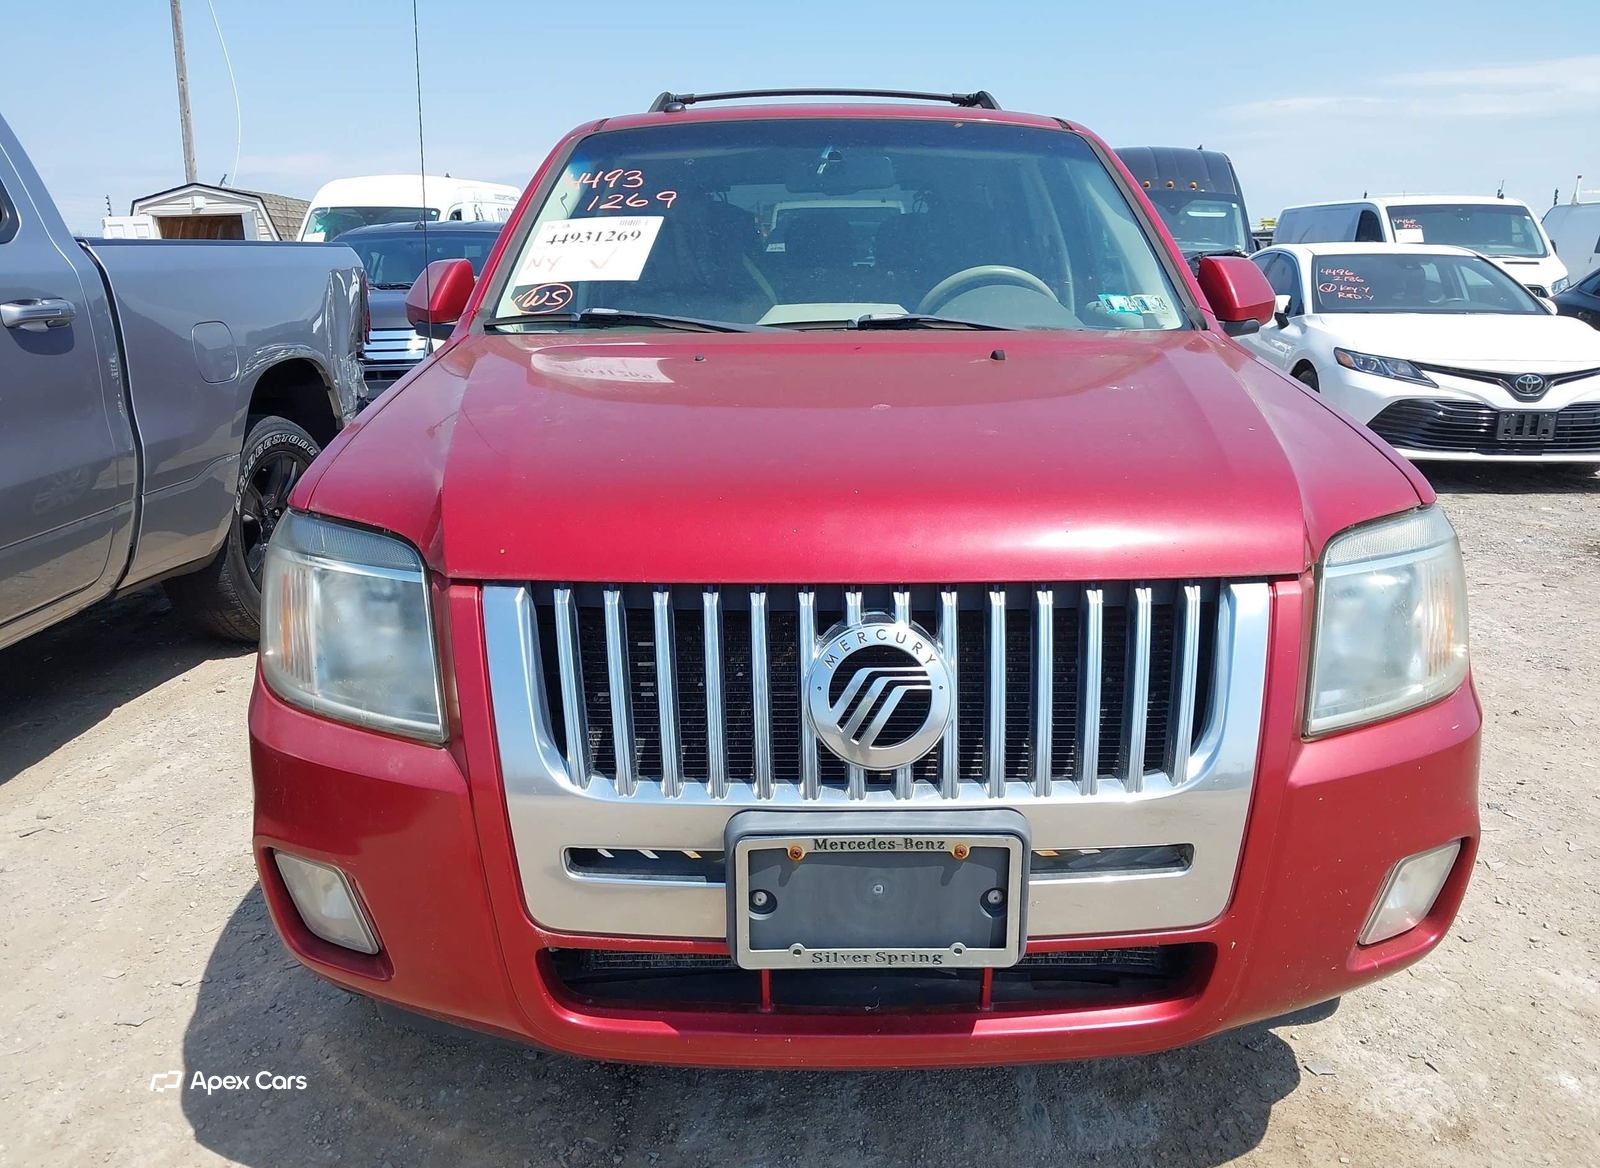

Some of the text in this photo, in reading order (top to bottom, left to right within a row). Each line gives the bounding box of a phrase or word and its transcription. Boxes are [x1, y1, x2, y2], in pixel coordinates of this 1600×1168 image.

[567, 168, 644, 190] 4493
[586, 190, 679, 212] 1269
[545, 229, 642, 246] 44931269
[824, 629, 937, 669] MERCURY
[812, 837, 946, 851] Mercedes-Benz
[811, 950, 944, 966] Silver Spring
